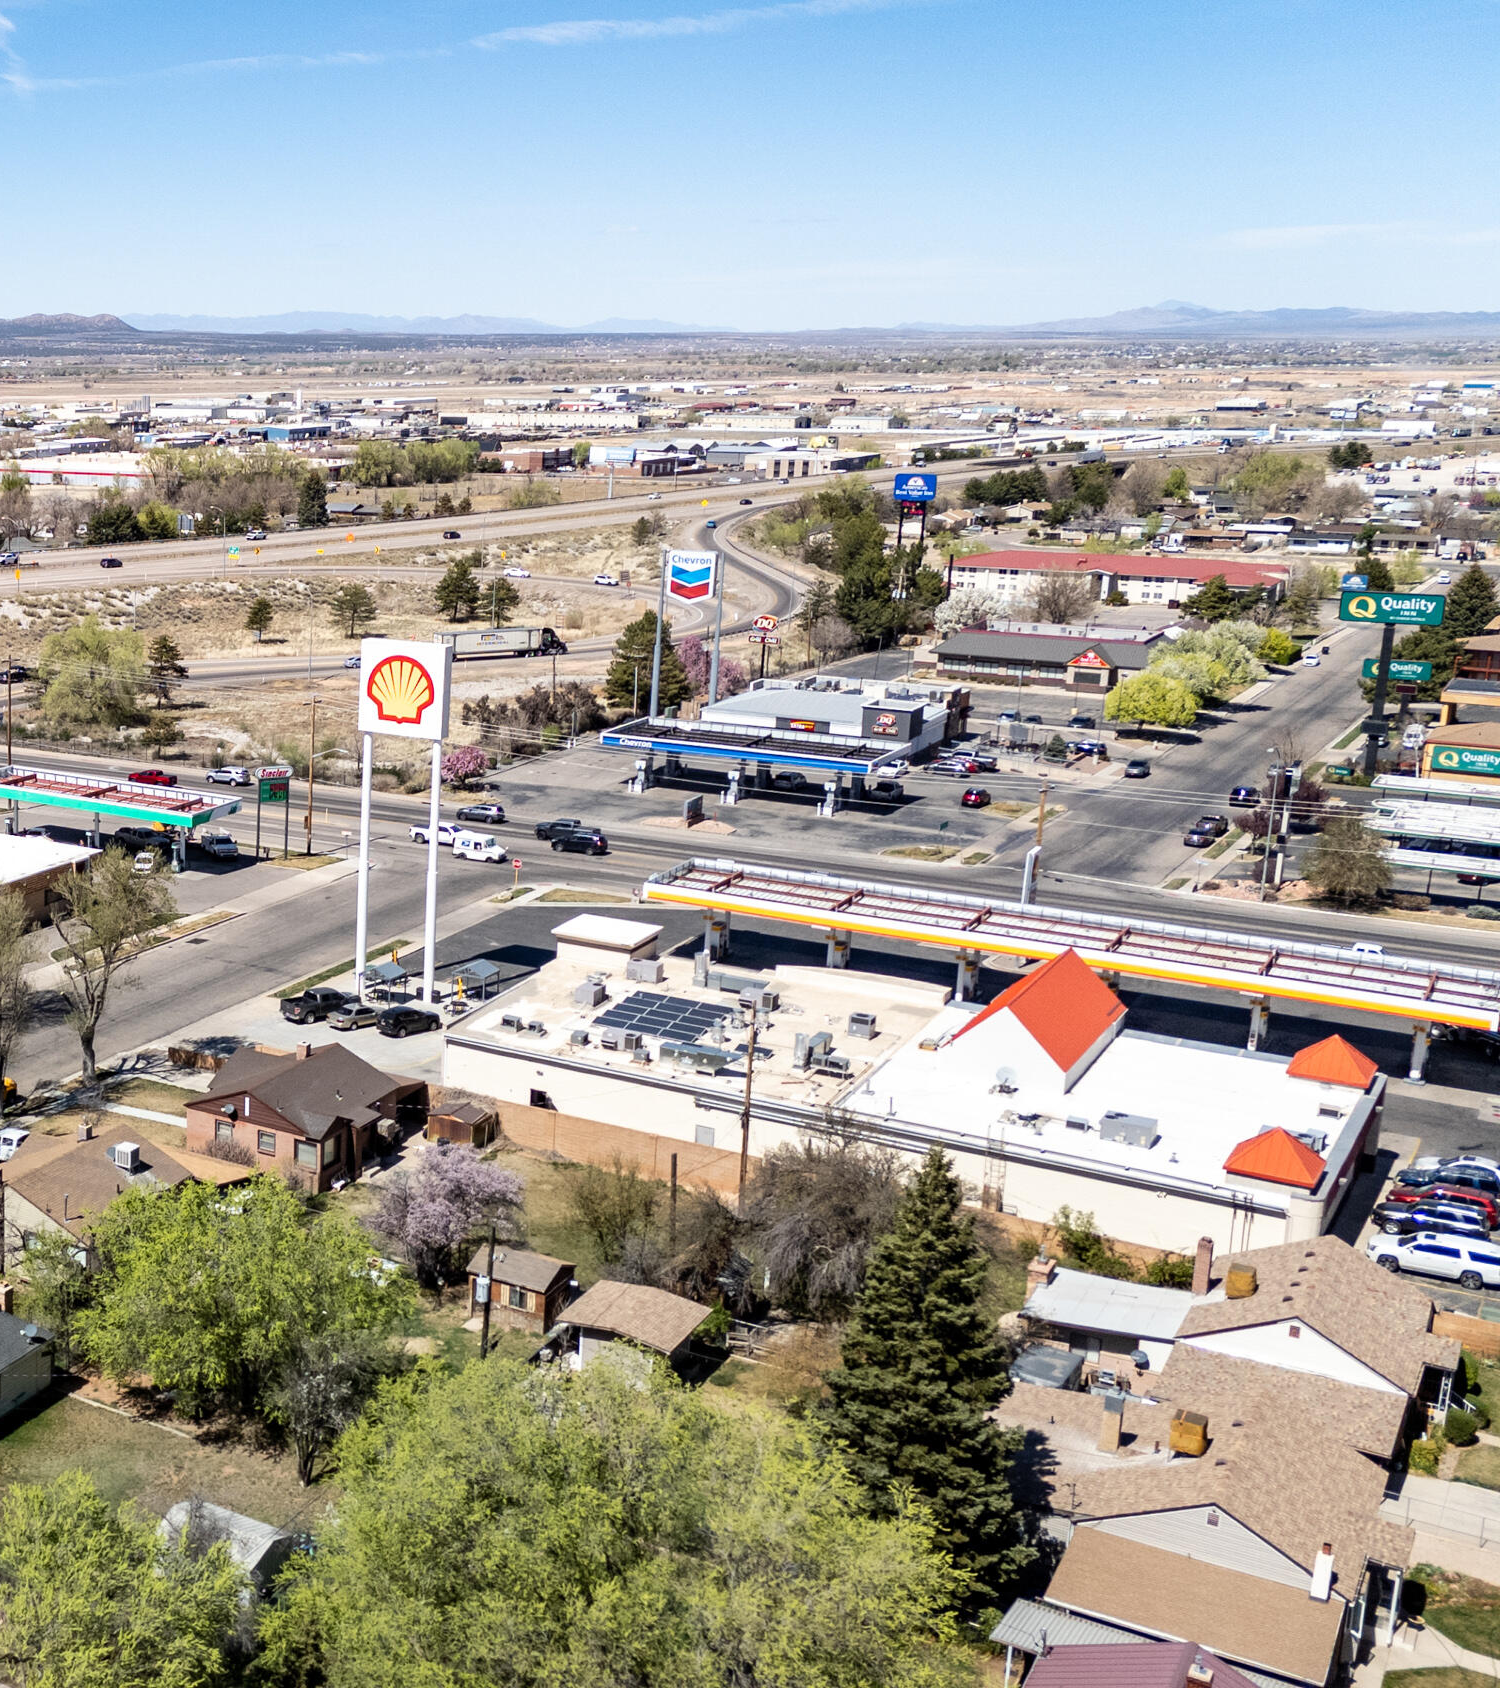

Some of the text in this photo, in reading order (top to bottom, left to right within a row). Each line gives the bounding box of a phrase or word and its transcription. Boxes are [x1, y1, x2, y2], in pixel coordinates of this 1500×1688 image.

[672, 554, 712, 565] Chevron
[1348, 596, 1436, 618] Q Quality
[757, 618, 774, 629] DQ
[1390, 663, 1423, 673] Quality
[620, 737, 652, 748] Chevron
[1439, 751, 1500, 767] Q Quality
[261, 768, 288, 778] Sinclair
